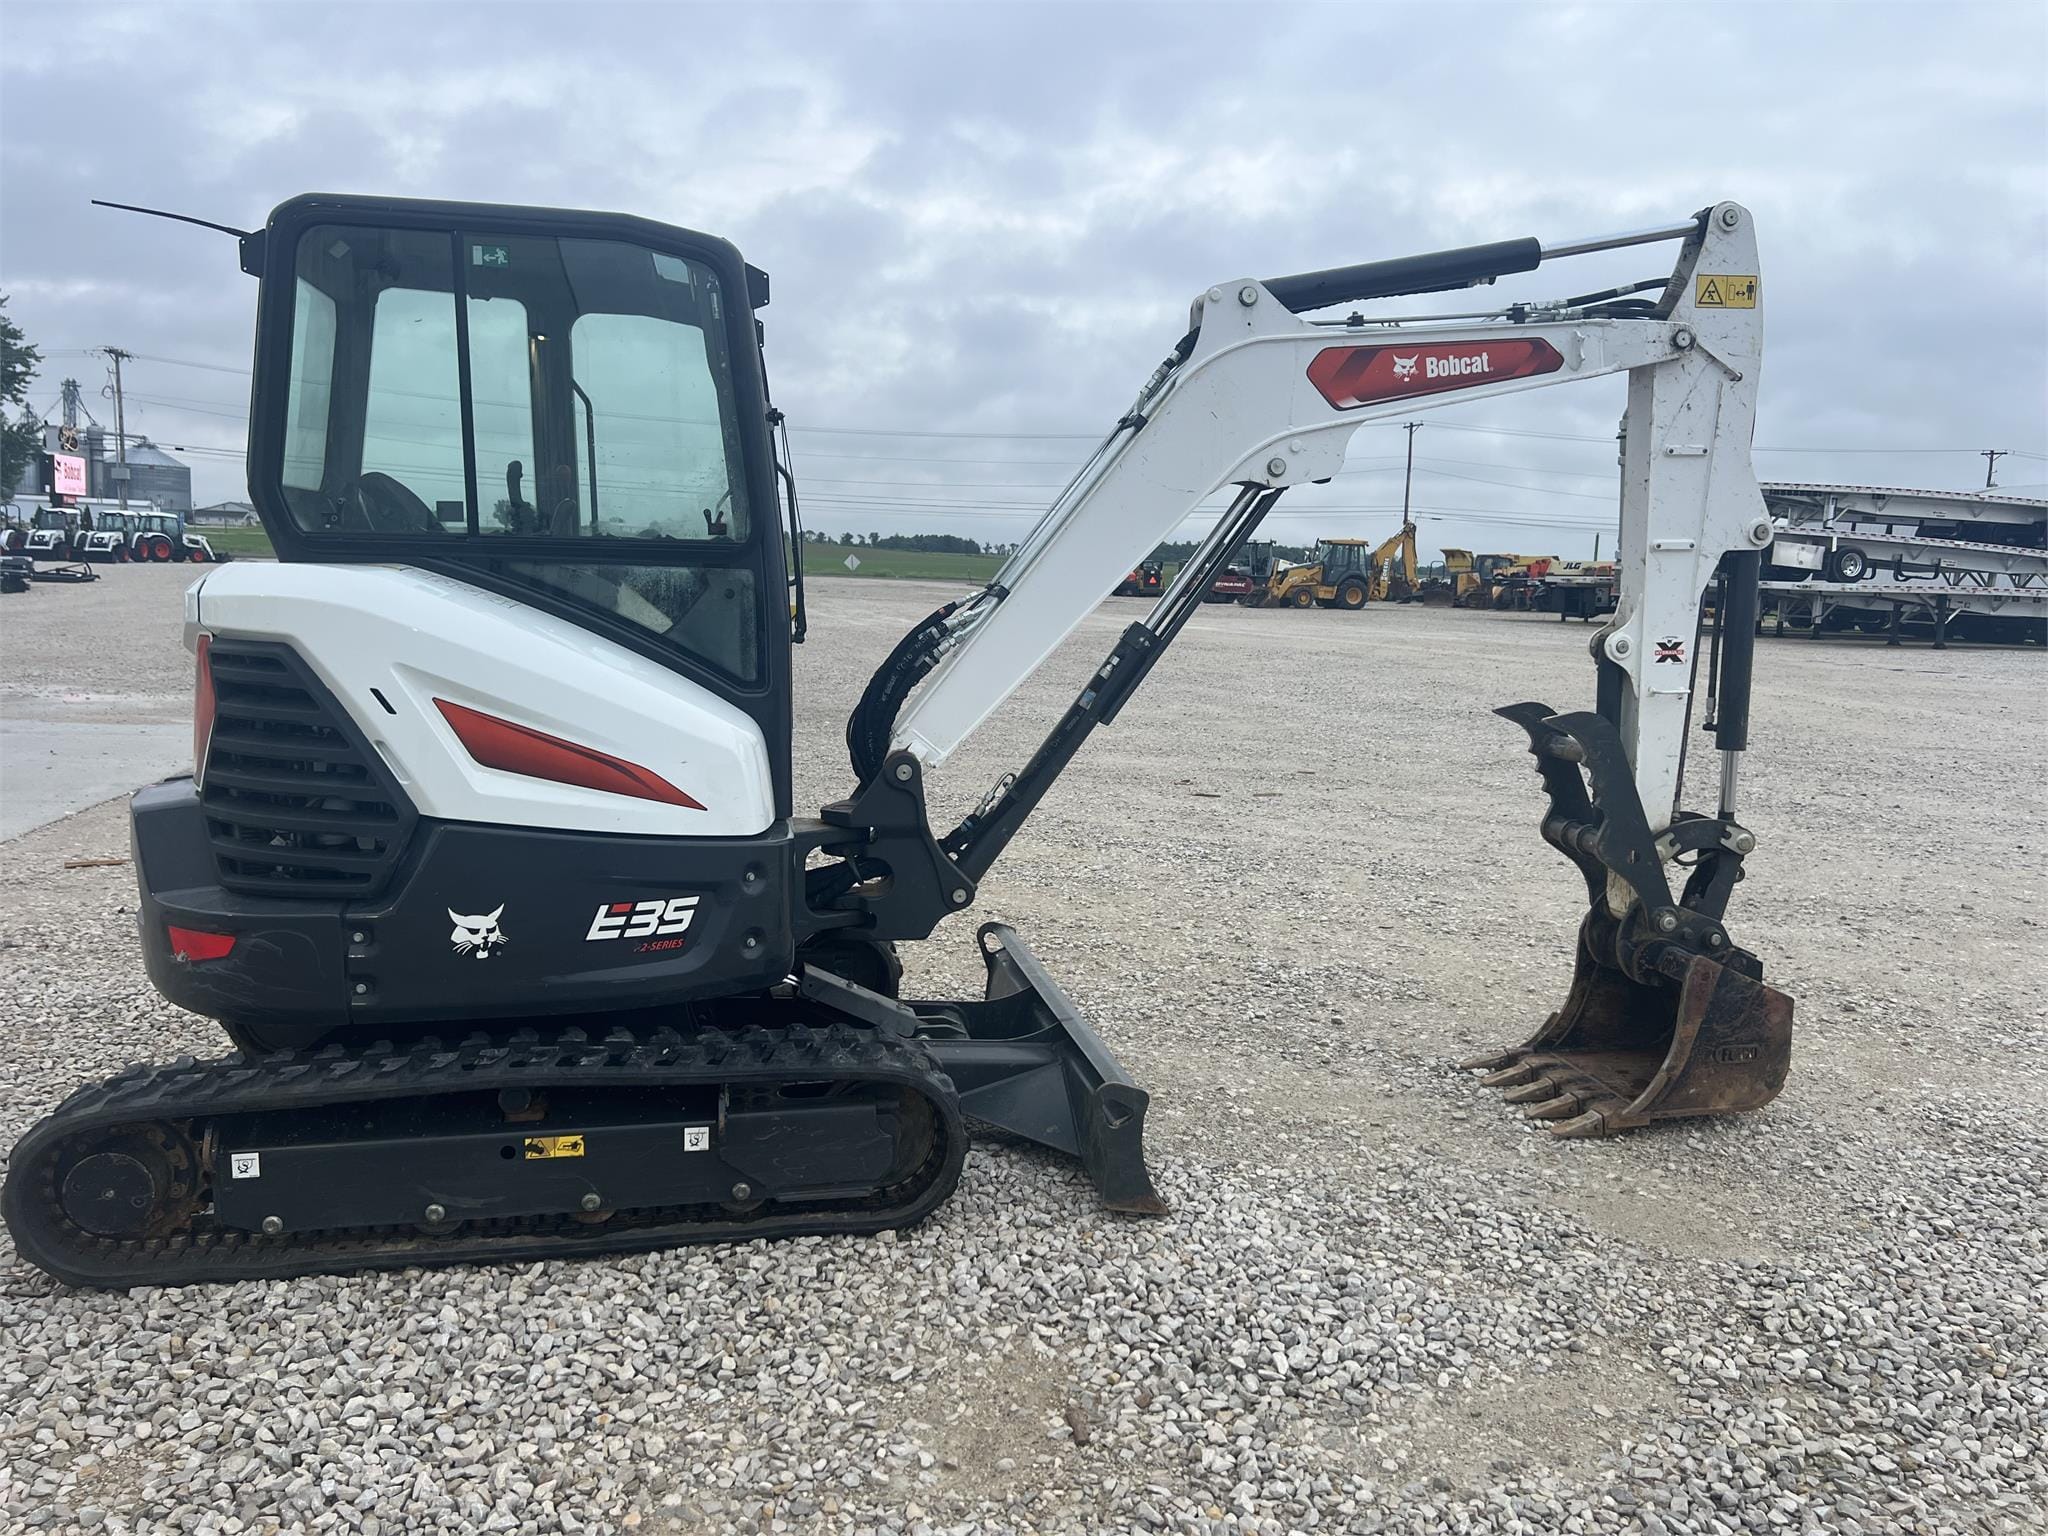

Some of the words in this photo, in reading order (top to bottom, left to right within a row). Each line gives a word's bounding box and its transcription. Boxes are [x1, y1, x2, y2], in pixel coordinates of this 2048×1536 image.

[1426, 352, 1489, 377] Bobcat
[1563, 562, 1582, 570] JLG
[585, 895, 700, 941] E35
[634, 938, 684, 952] 2-SERIES
